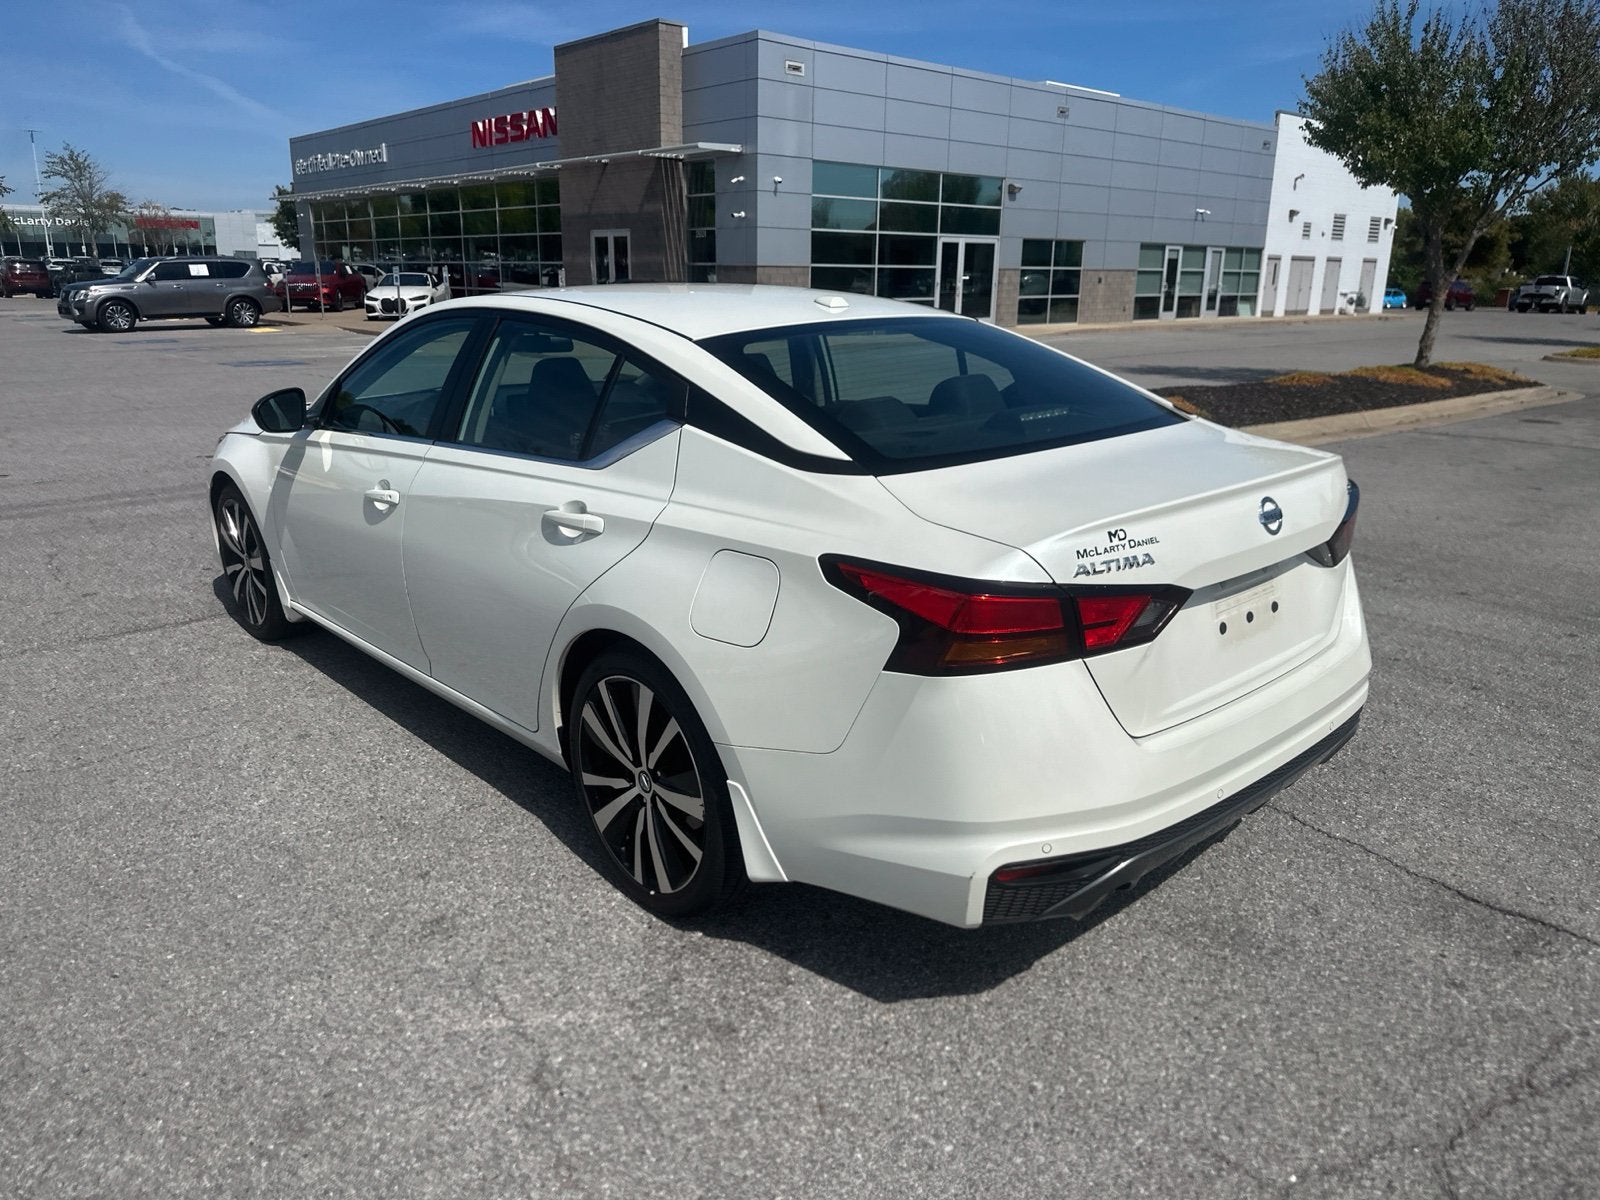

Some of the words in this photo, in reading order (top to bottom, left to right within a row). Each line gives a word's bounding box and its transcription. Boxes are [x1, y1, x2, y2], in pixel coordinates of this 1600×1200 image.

[471, 106, 558, 149] NISSAN
[1107, 528, 1127, 543] MD
[1072, 552, 1156, 579] ALTIMA
